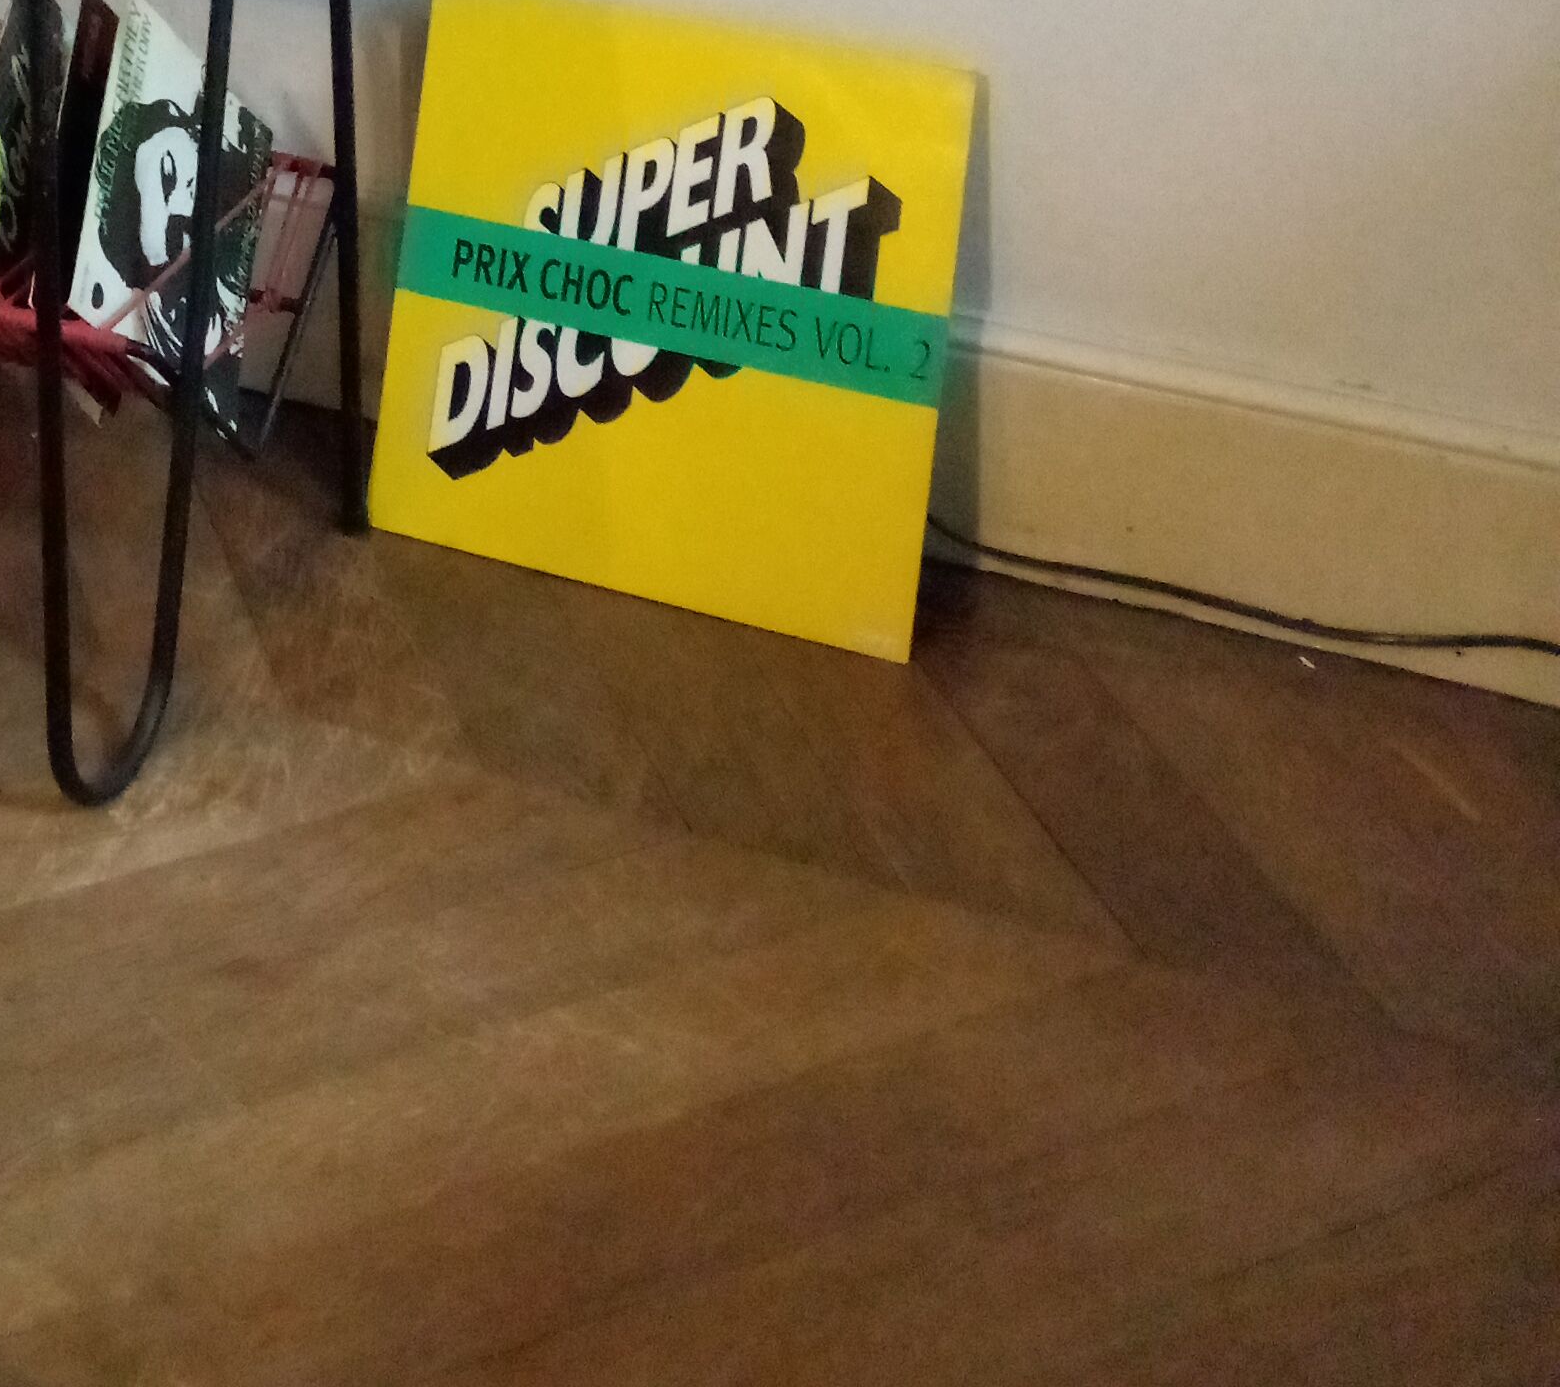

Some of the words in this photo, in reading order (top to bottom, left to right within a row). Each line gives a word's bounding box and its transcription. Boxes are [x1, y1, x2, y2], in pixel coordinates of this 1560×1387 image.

[452, 238, 531, 294] PRIX
[540, 258, 634, 316] CHOC
[648, 281, 798, 352] REMIXES
[816, 316, 891, 372] VOL.
[910, 339, 932, 379] 2
